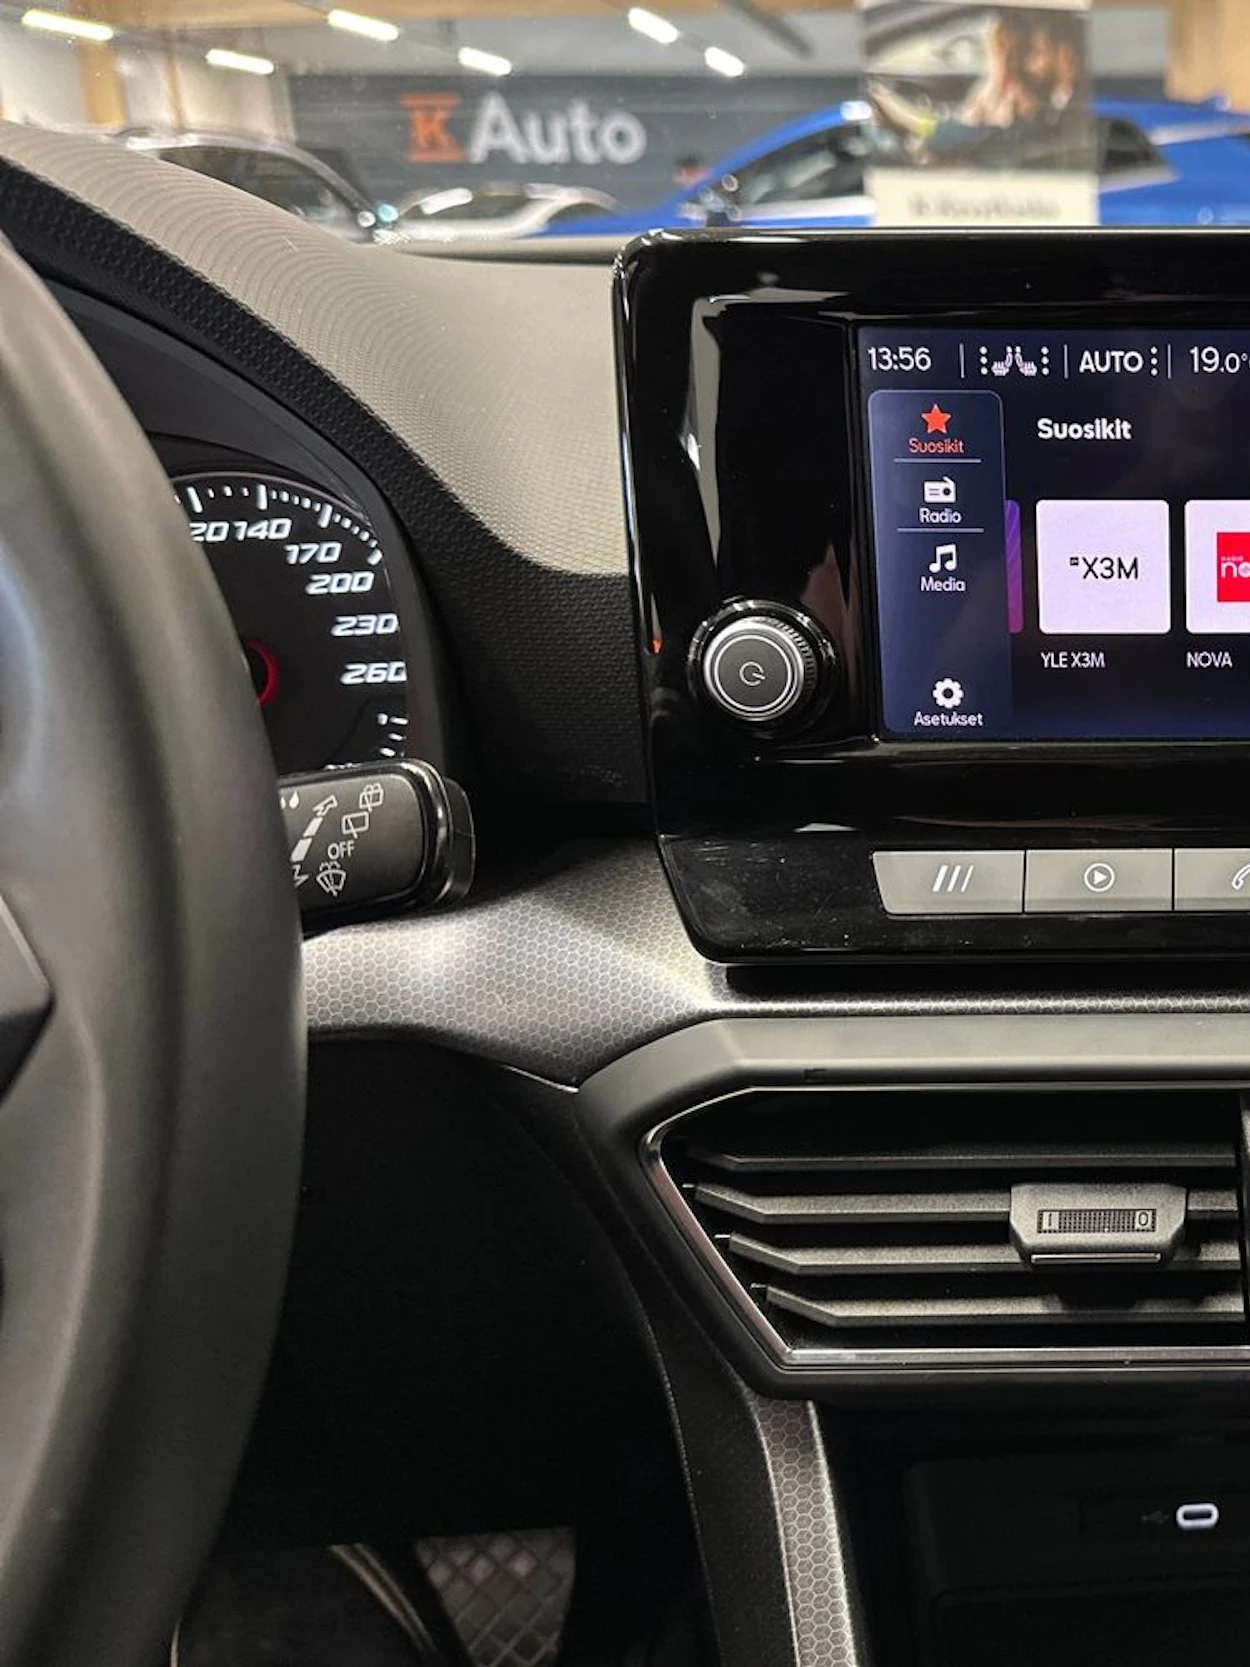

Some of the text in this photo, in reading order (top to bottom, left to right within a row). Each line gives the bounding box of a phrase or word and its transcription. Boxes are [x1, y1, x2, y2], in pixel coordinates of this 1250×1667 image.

[469, 90, 648, 165] Auto
[867, 346, 932, 372] 13:56
[1079, 350, 1144, 373] AUTO
[1037, 417, 1132, 440] Suosikit
[908, 438, 964, 454] Suosikit
[919, 507, 961, 524] Radio
[189, 521, 230, 542] 20
[233, 517, 292, 541] 140
[284, 541, 342, 565] 170
[1082, 556, 1139, 579] X3M
[305, 571, 375, 595] 200
[920, 576, 966, 592] Media
[331, 614, 400, 637] 230
[1041, 652, 1105, 668] YLE X3M
[1187, 652, 1233, 668] NOVA
[340, 660, 408, 685] 260
[914, 711, 983, 727] Asetukset
[327, 840, 356, 860] OFF
